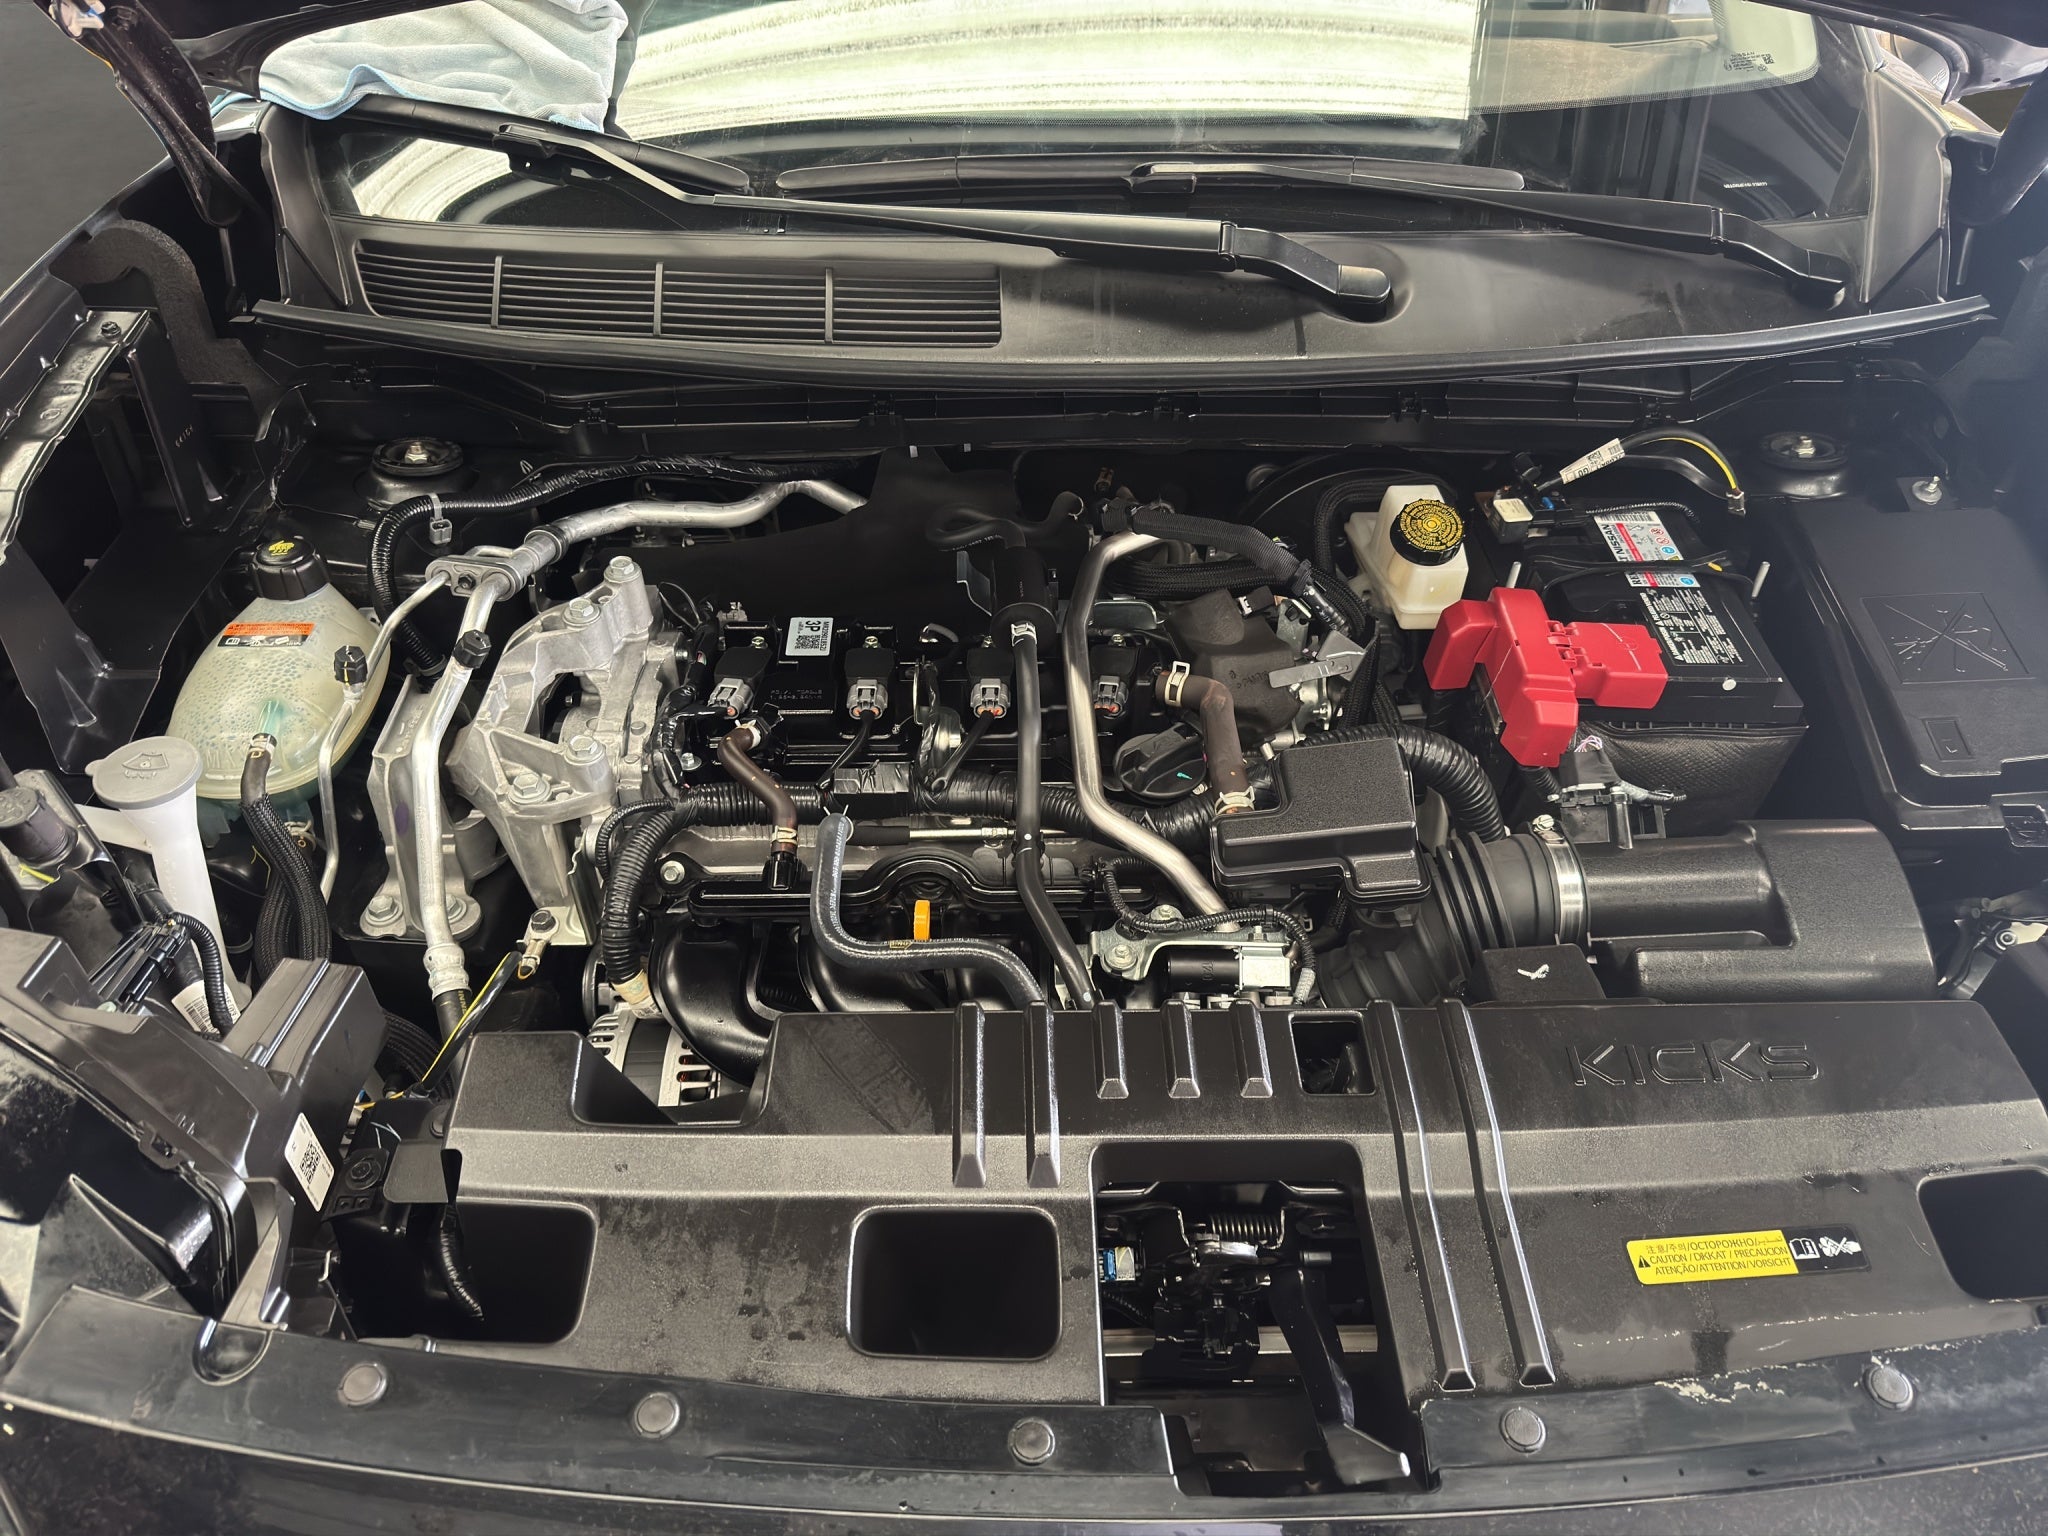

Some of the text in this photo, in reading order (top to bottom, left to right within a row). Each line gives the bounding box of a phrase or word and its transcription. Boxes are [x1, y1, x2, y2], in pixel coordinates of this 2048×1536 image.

[1601, 524, 1625, 555] NISSAN
[805, 620, 821, 632] 3P
[1566, 1042, 1819, 1086] KICKS
[1650, 1253, 1688, 1265] CAUTION
